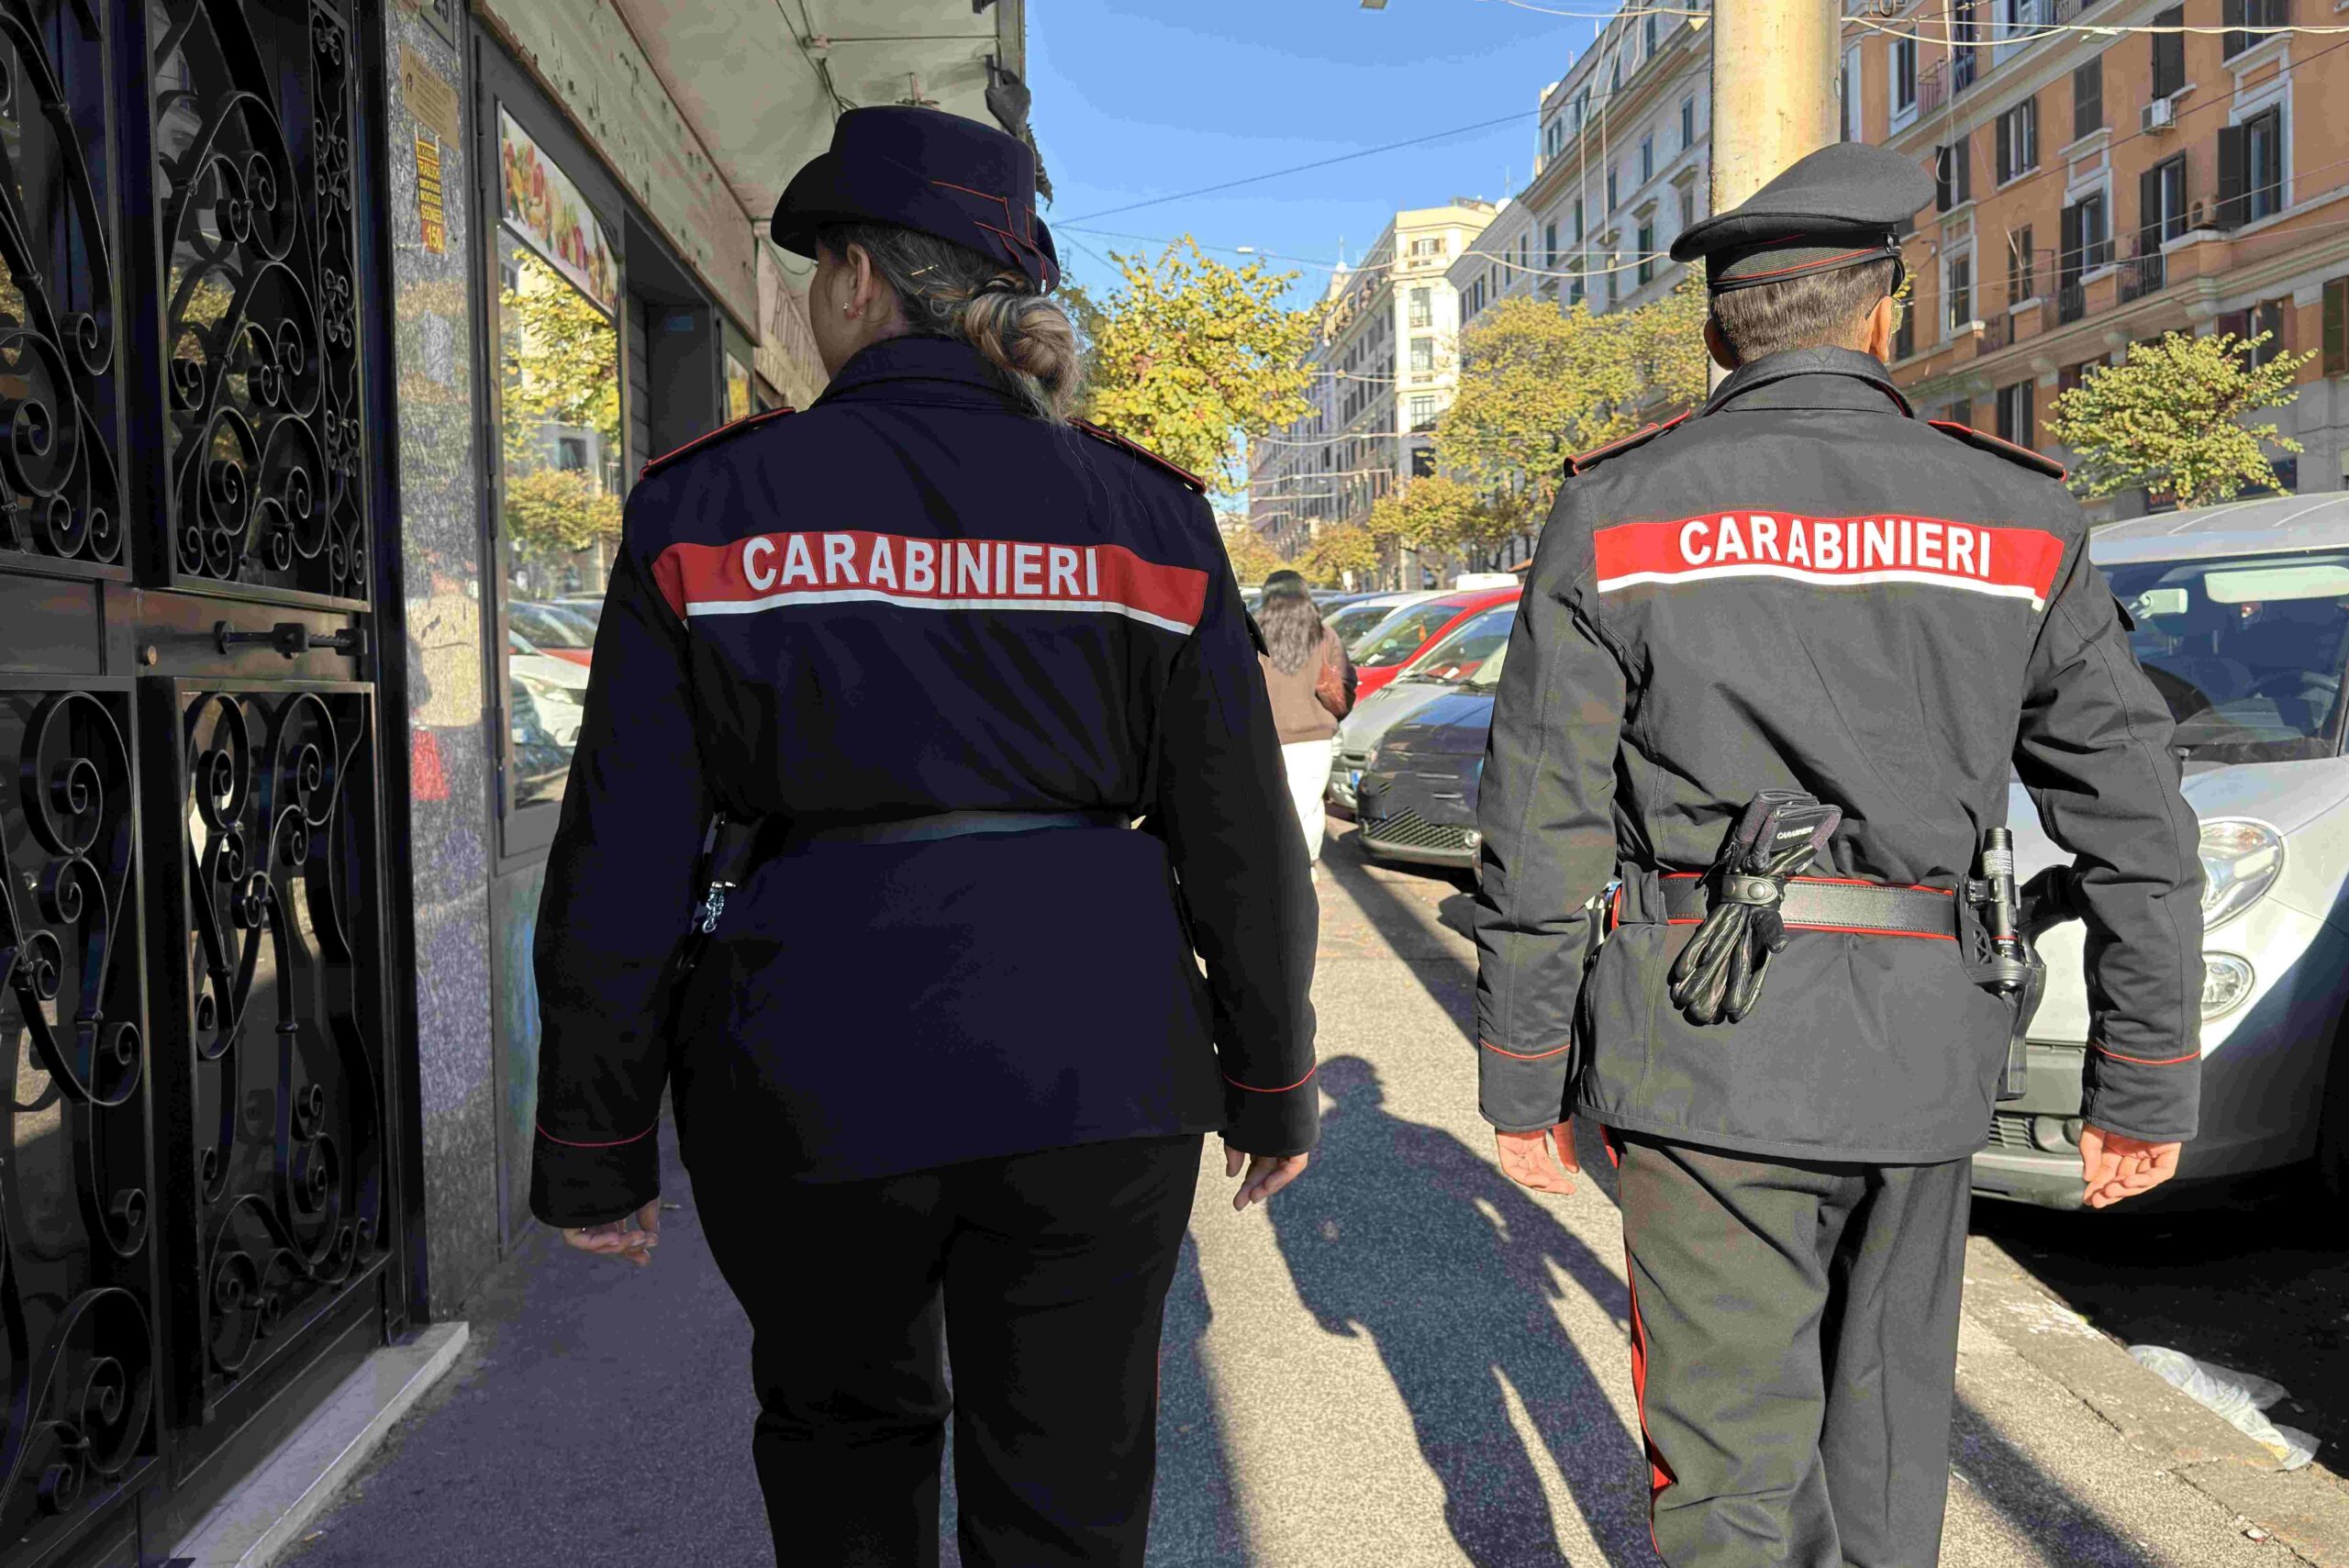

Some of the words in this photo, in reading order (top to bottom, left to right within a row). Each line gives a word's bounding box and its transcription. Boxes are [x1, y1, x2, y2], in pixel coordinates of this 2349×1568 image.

[426, 224, 443, 250] 150
[741, 533, 1099, 596] CARABINIERI
[1678, 515, 1992, 579] CARABINIERI
